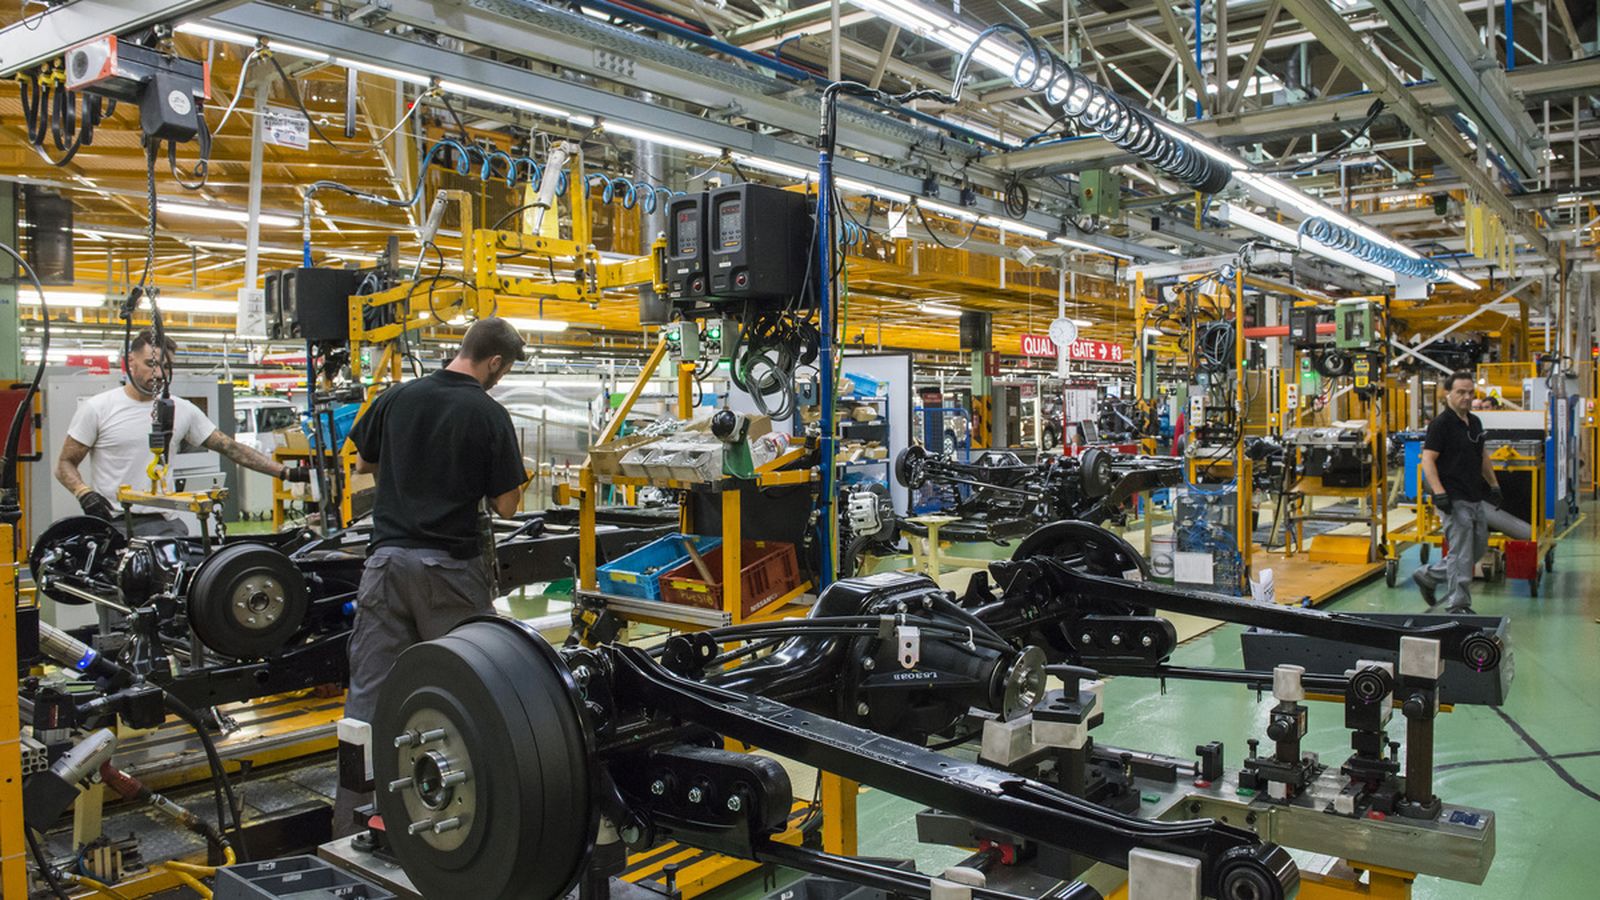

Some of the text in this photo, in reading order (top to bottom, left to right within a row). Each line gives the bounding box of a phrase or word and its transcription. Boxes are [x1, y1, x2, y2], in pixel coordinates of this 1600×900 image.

[1024, 337, 1122, 361] QUALI GATE #3
